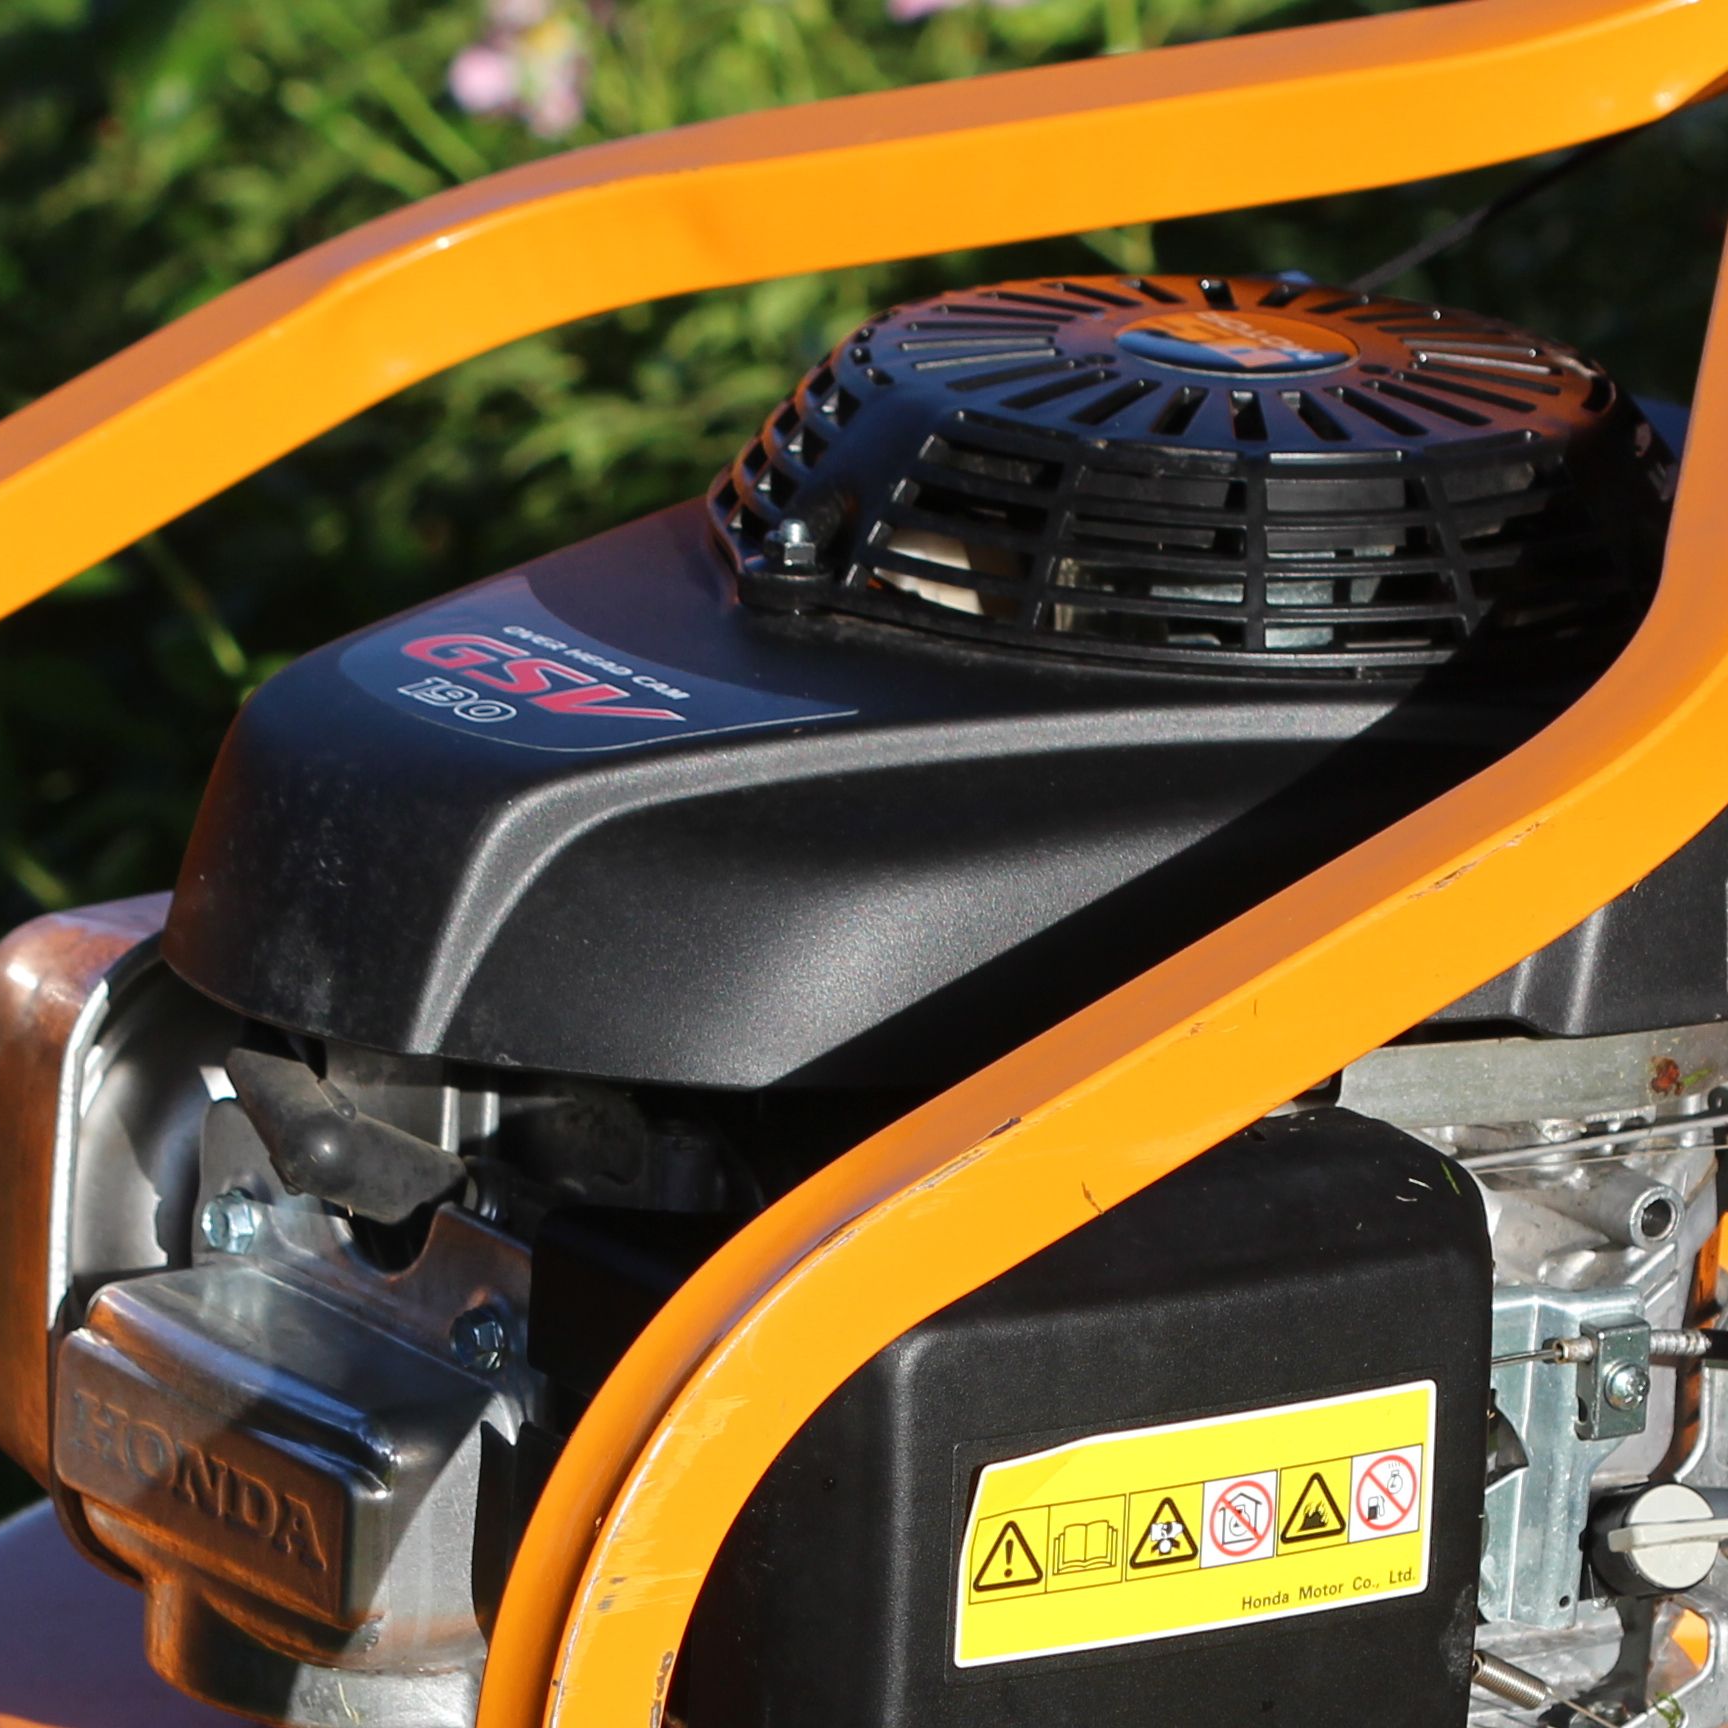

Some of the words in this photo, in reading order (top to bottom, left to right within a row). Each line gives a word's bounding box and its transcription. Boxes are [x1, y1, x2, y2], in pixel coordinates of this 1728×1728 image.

[396, 676, 518, 723] 190
[400, 633, 687, 721] GSV
[502, 625, 569, 651] OVER
[563, 648, 633, 676] HEAD
[631, 675, 691, 700] CAM
[72, 1389, 328, 1572] HONDA
[1241, 1590, 1290, 1611] Honda
[1298, 1582, 1345, 1601] Motor
[1352, 1575, 1380, 1591] Co.,
[1388, 1567, 1416, 1585] Ltd.
